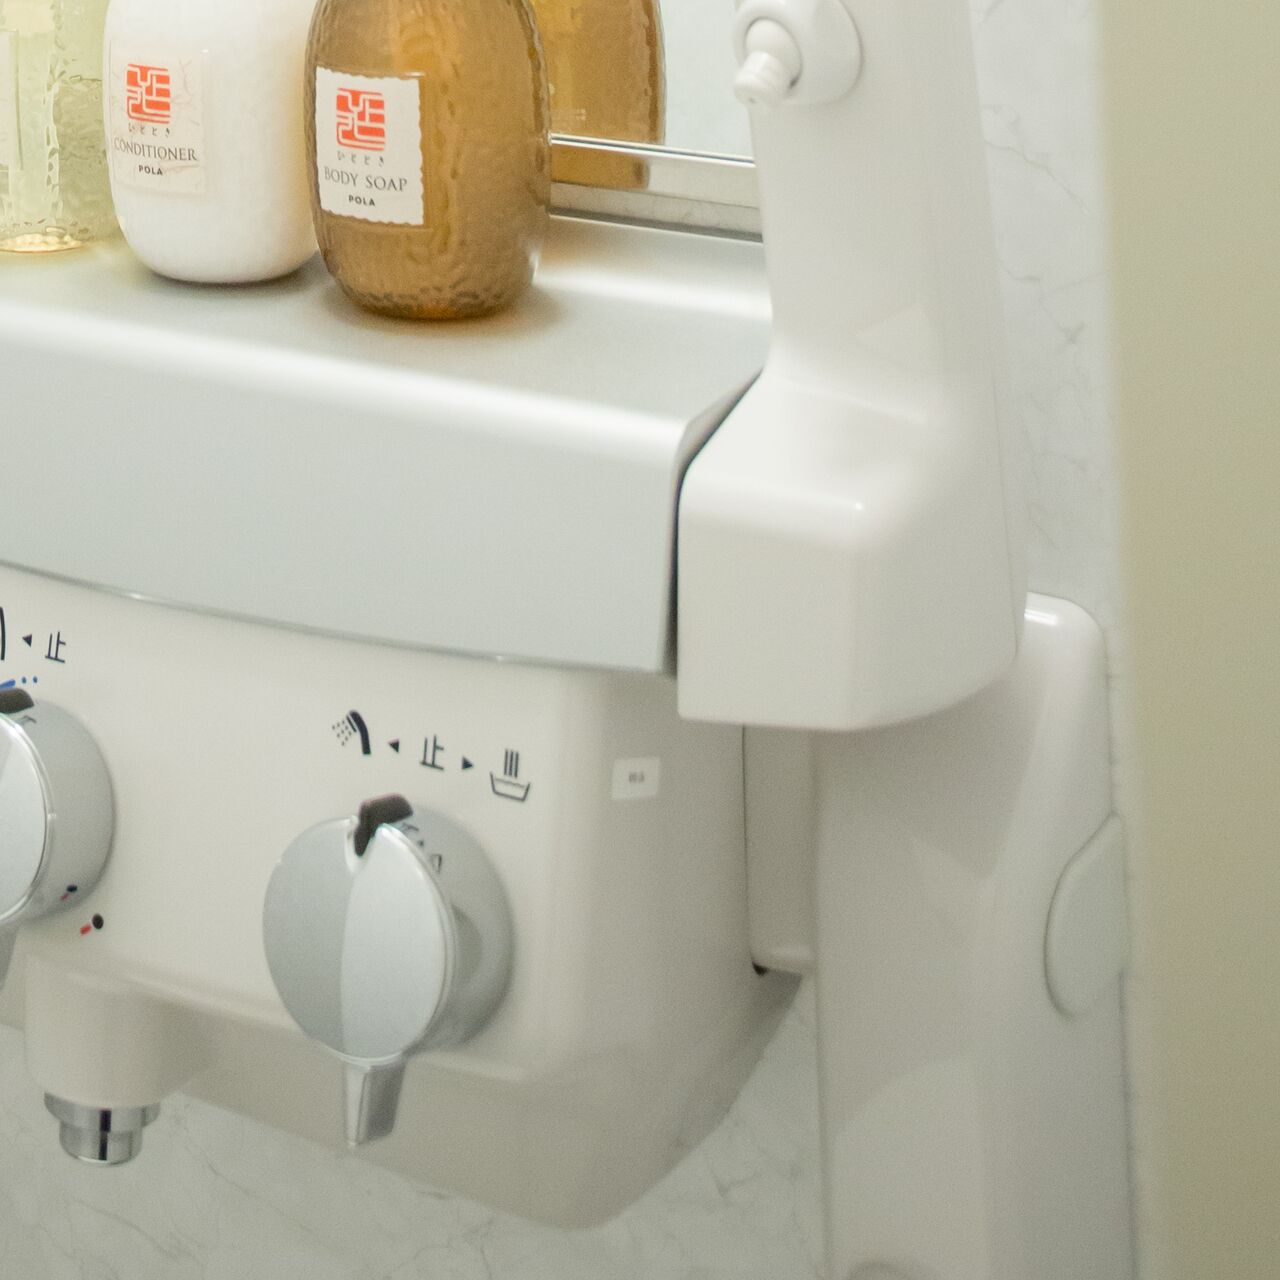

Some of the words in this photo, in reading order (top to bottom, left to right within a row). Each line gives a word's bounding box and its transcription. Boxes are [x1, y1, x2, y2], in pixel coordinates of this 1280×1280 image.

[113, 136, 198, 161] CONDITIONER
[138, 164, 163, 176] POLA
[324, 165, 358, 187] BODY
[365, 175, 407, 192] SOAP
[348, 194, 376, 207] POLA
[44, 631, 66, 663] 止
[419, 734, 445, 771] 止
